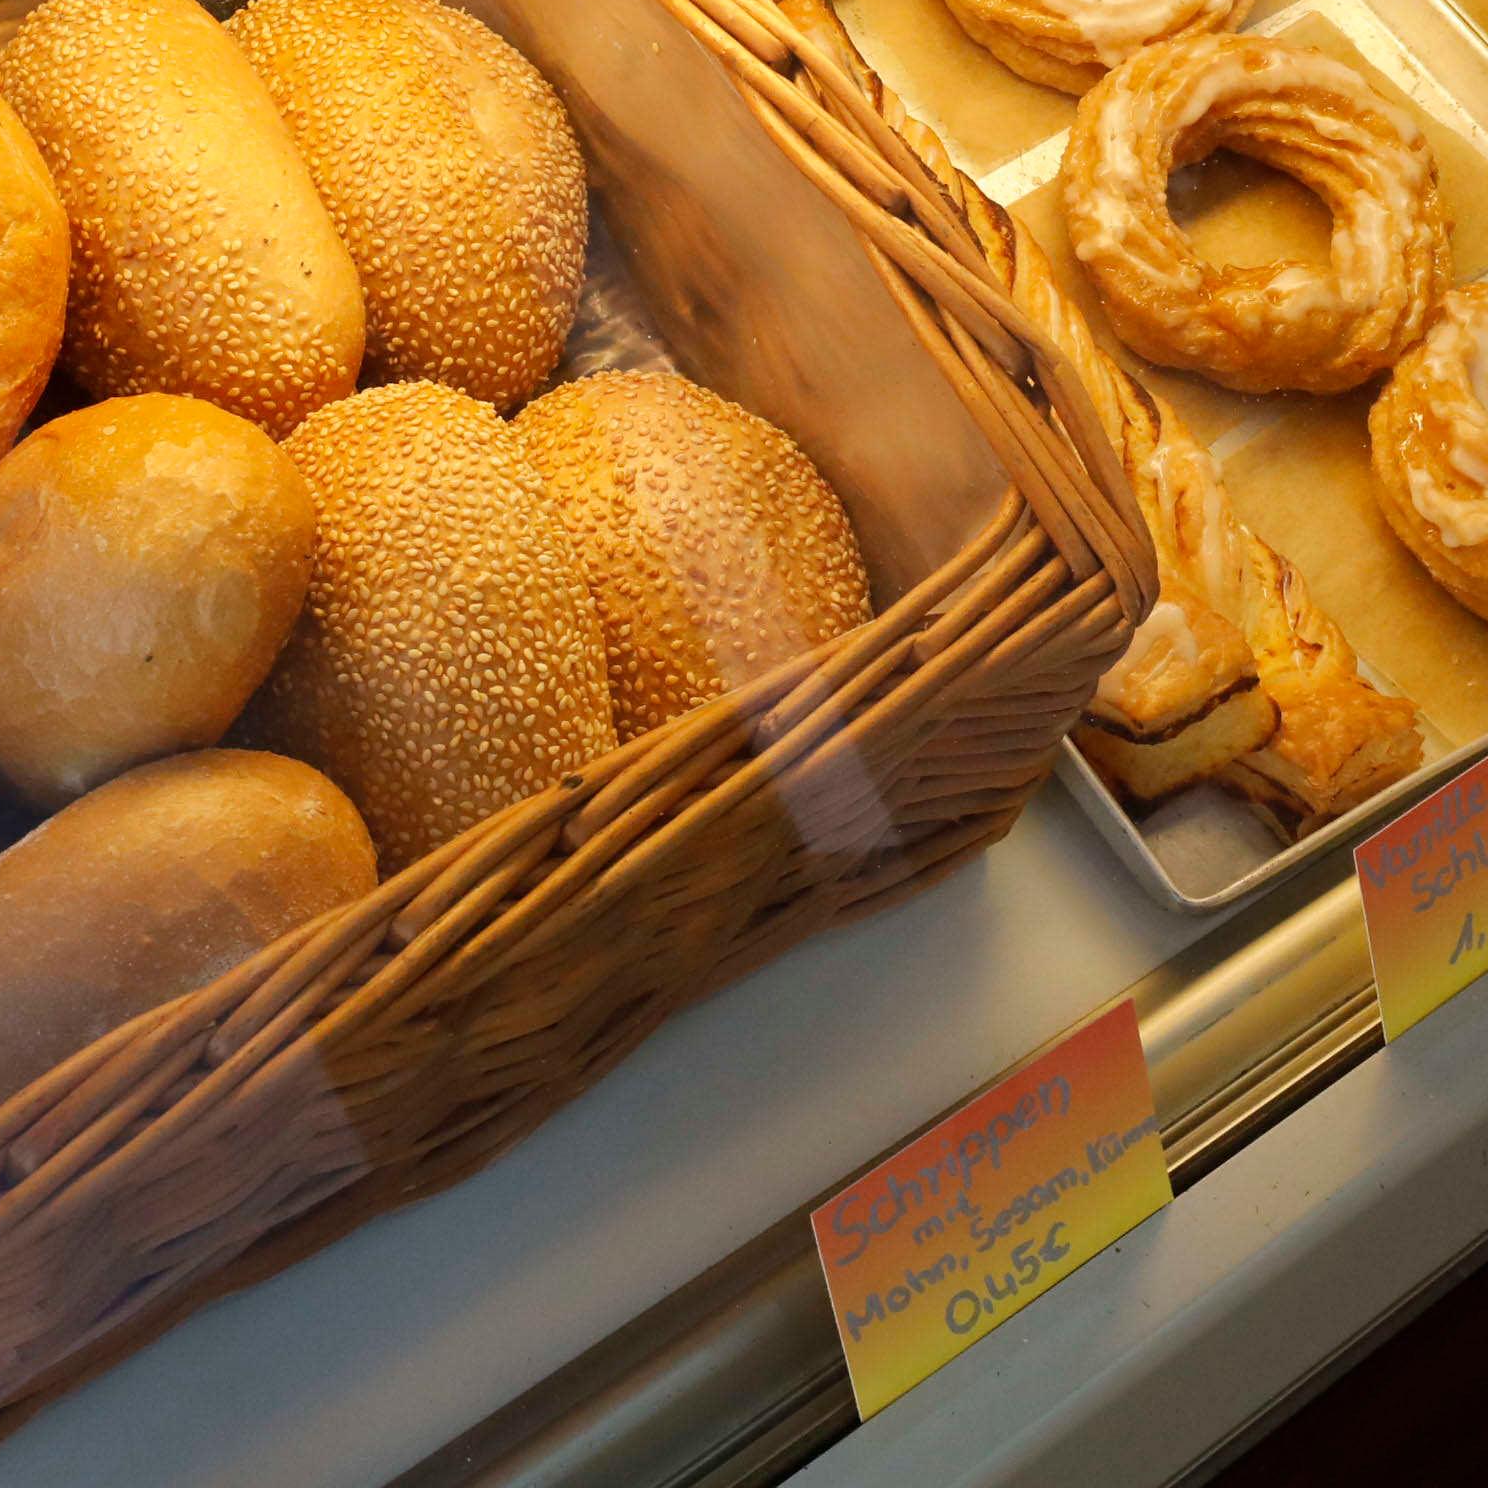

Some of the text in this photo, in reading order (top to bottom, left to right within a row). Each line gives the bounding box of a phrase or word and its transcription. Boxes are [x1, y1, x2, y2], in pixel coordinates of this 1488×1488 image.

[831, 1074, 1072, 1267] Schrippen
[912, 1189, 982, 1246] mit
[844, 1251, 970, 1342] Mohn,
